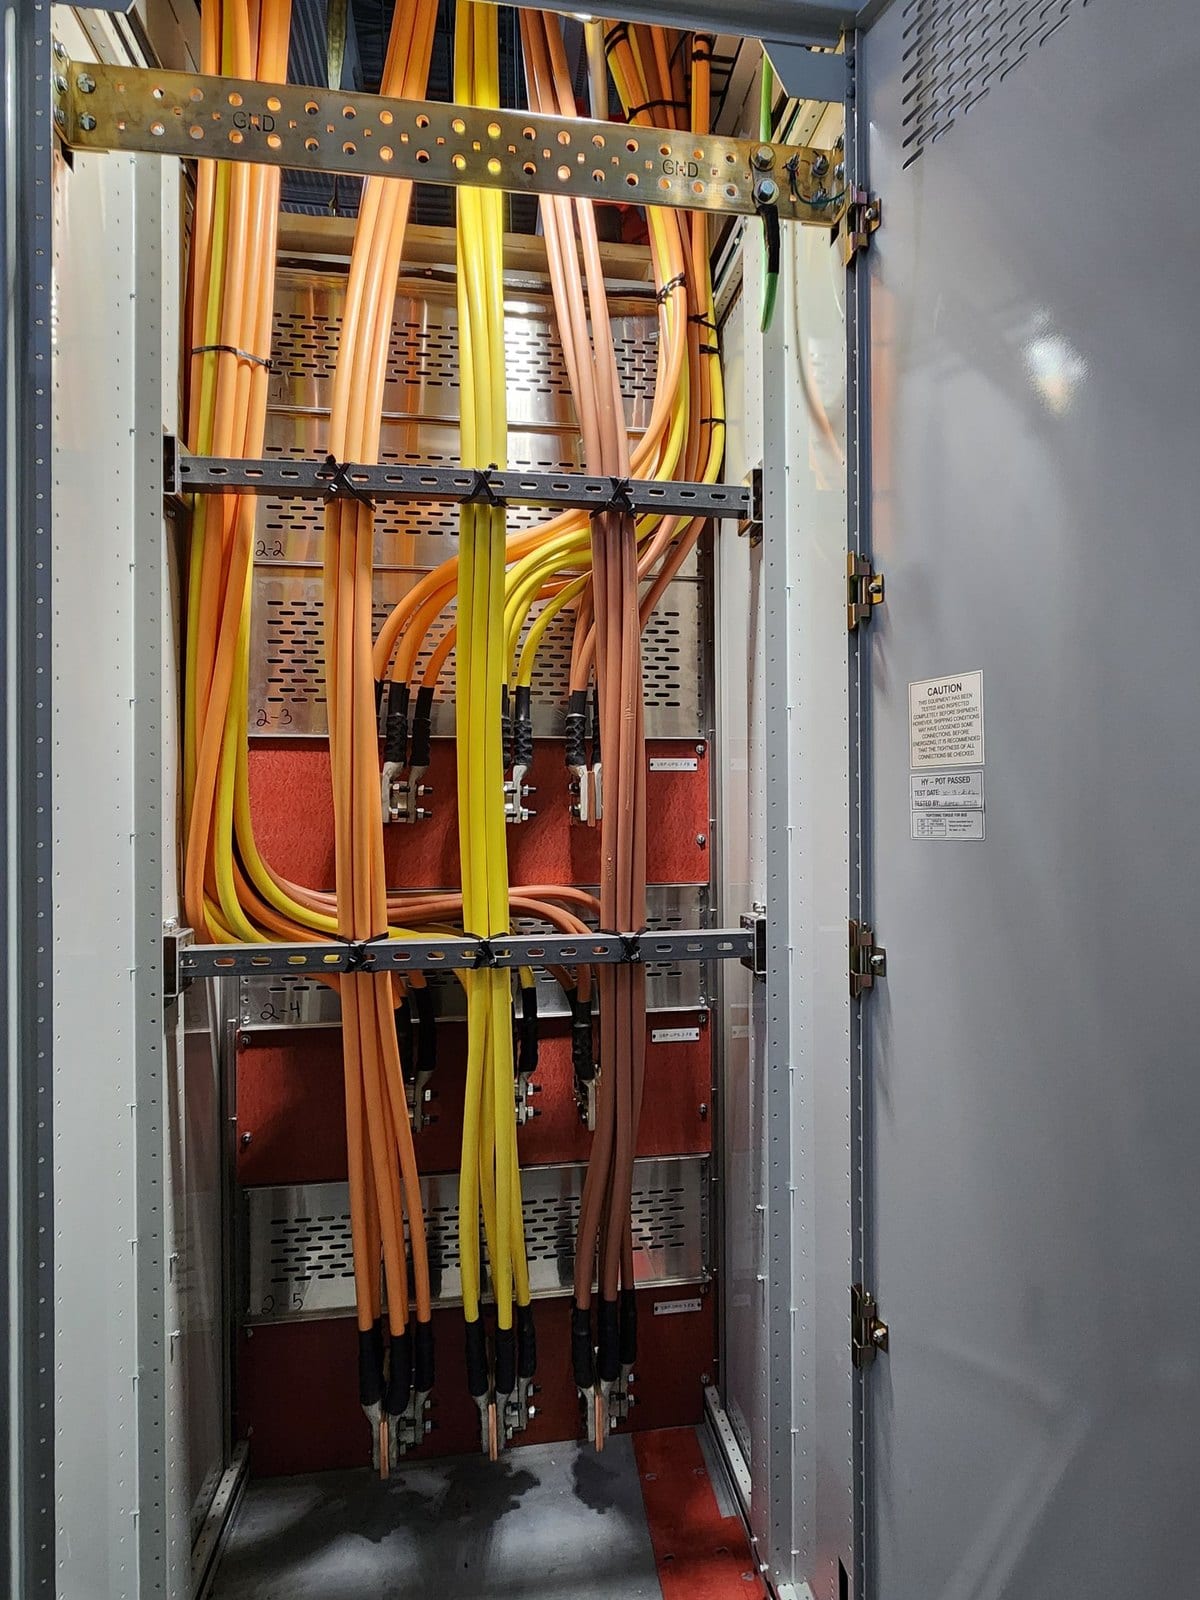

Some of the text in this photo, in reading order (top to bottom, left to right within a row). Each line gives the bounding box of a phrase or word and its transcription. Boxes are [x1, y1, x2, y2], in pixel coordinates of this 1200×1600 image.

[255, 540, 285, 557] 2-2
[928, 683, 962, 696] CAUTION
[256, 708, 293, 727] 2-3
[948, 776, 970, 784] PASSED
[260, 1000, 301, 1020] 2-4
[261, 1292, 304, 1315] 2-5
